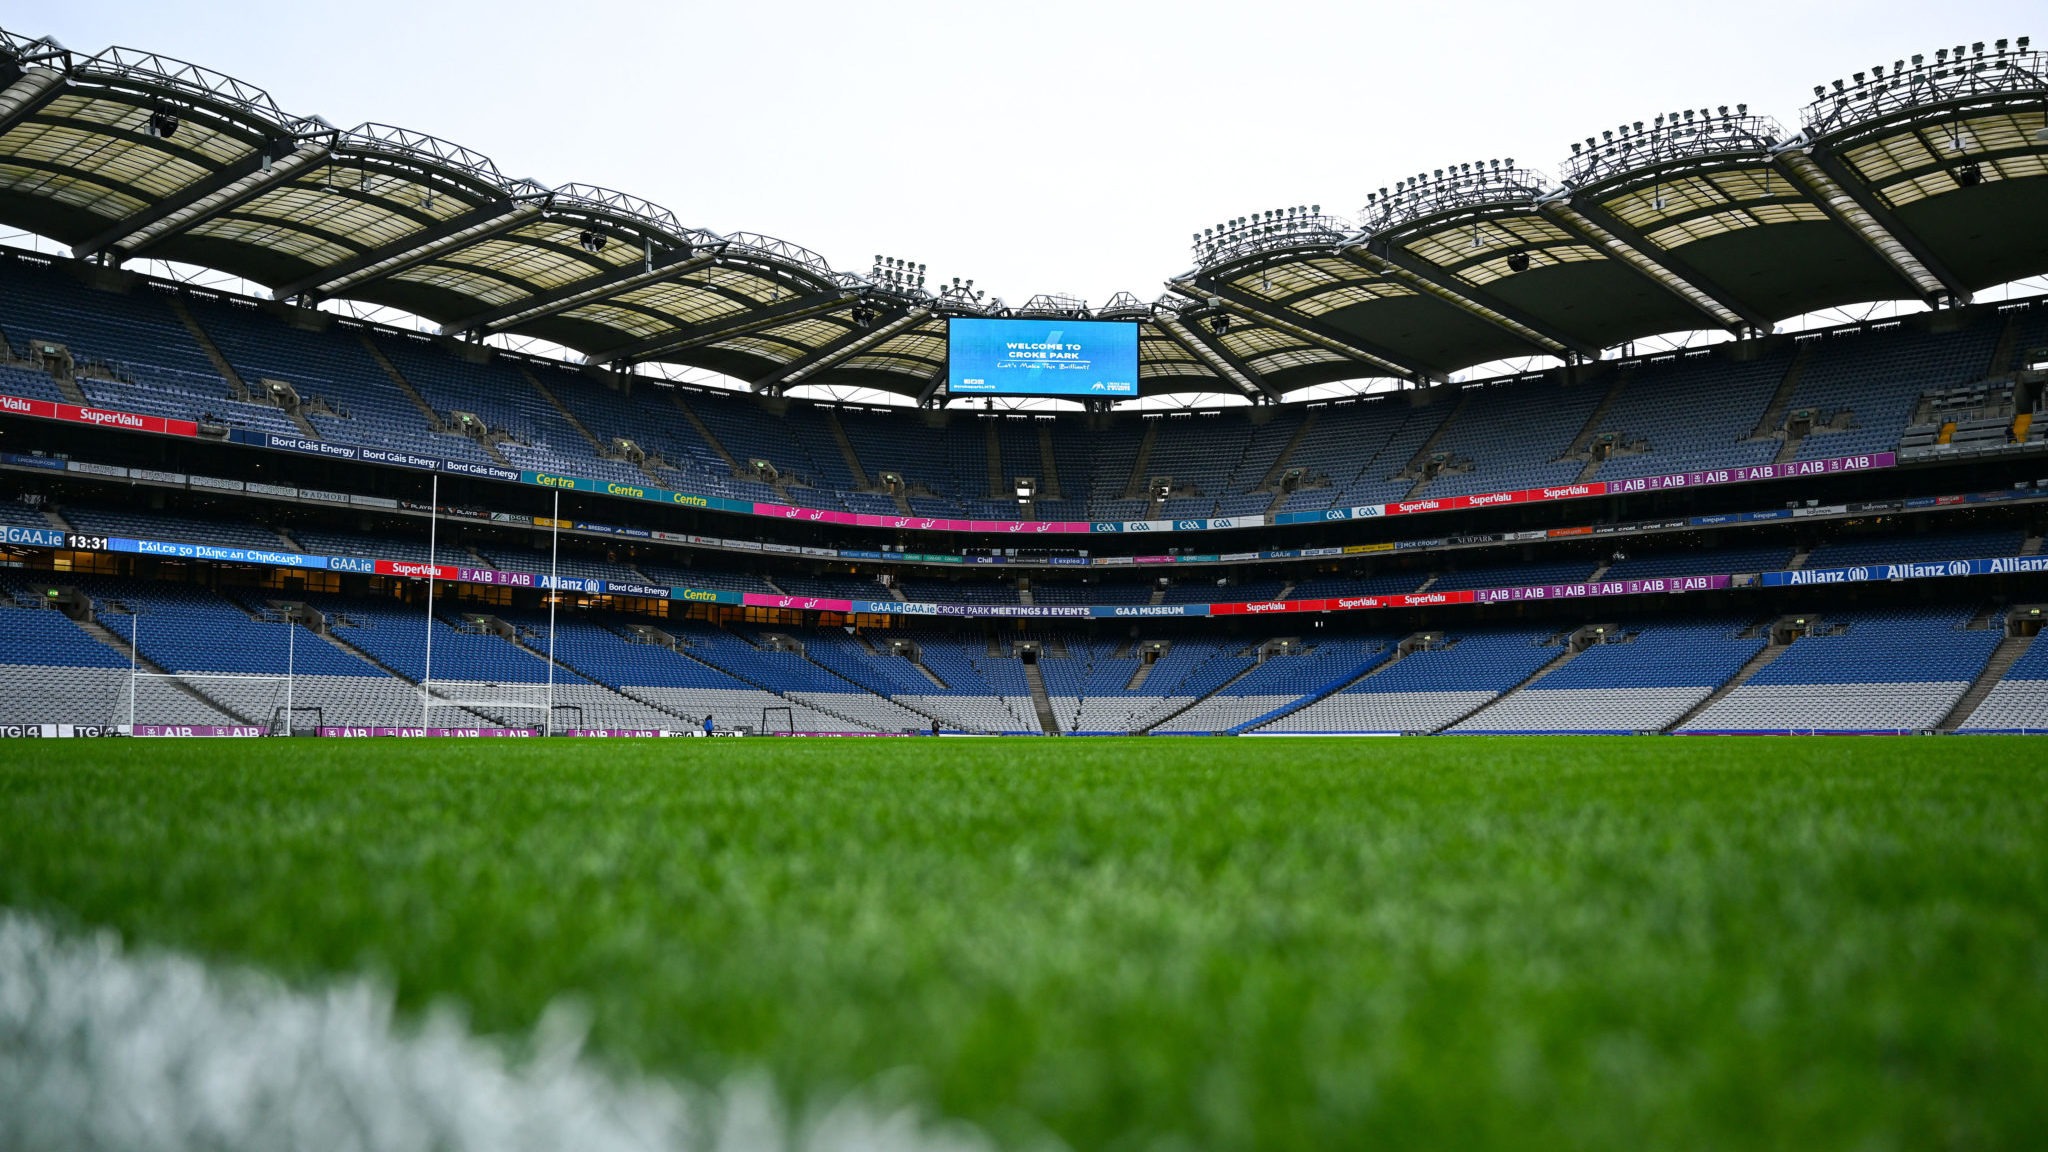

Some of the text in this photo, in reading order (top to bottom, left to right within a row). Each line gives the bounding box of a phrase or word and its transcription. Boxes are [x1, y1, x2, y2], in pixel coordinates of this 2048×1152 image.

[1006, 342, 1081, 351] WELCOME TO
[1008, 351, 1079, 360] CROKE PARK
[1043, 362, 1056, 370] This
[80, 408, 143, 427] SuperValu
[271, 436, 356, 458] Bord Gáis Energy
[363, 449, 386, 460] Bord
[387, 452, 407, 464] Gáis
[1799, 461, 1825, 475] AIB
[1843, 456, 1870, 470] AIB
[447, 461, 519, 480] Bord Gáis Energy
[1750, 466, 1774, 479] AIB
[536, 473, 576, 489] Centra
[1662, 475, 1685, 487] AIB
[1705, 471, 1729, 483] AIB
[607, 483, 644, 498] Centra
[1624, 479, 1646, 491] AIB
[311, 491, 348, 503] ADMORE
[1543, 484, 1589, 499] SuperValu
[673, 493, 707, 507] Centra
[1469, 493, 1512, 506] SuperValu
[1358, 506, 1378, 517] GAA
[1399, 500, 1439, 513] SuperValu
[786, 507, 800, 518] eir
[810, 509, 824, 520] eir
[1326, 509, 1345, 520] GAA
[1753, 511, 1778, 519] Kingspan
[587, 523, 612, 532] BREEDON
[895, 517, 910, 528] eir
[921, 518, 936, 529] eir
[1009, 521, 1025, 532] eir
[1036, 521, 1052, 532] eir
[1096, 523, 1117, 532] GAA
[1130, 522, 1150, 531] GAA
[1179, 520, 1200, 530] GAA
[1213, 518, 1232, 528] GAA
[9, 528, 62, 546] GAA.ie
[626, 529, 649, 537] BREEDON
[69, 535, 108, 550] 13:31
[1457, 535, 1493, 544] NEWPARK
[179, 546, 193, 557] go
[230, 551, 244, 559] an
[330, 557, 372, 572] GAA.ie
[977, 556, 993, 564] Chill
[1989, 557, 2048, 573] Allianz
[472, 570, 493, 582] AIB
[1887, 563, 1945, 579] Allianz
[510, 574, 530, 585] AIB
[540, 575, 583, 590] Allianz
[1684, 578, 1707, 588] AIB
[1790, 570, 1845, 585] Allianz
[609, 583, 669, 597] Bord Gáis Energy
[1565, 585, 1586, 596] AIB
[1601, 583, 1623, 593] AIB
[1642, 580, 1664, 591] AIB
[684, 589, 717, 601] Centra
[1489, 589, 1509, 600] AIB
[1524, 588, 1545, 598] AIB
[779, 596, 794, 608] eir
[804, 597, 818, 609] eir
[1338, 597, 1377, 608] SuperValu
[1404, 594, 1445, 606] SuperValu
[870, 602, 902, 613] GAA.ie
[904, 603, 935, 614] GAA.ie
[936, 605, 1090, 615] CROKE PARK MEETINGS & EVENTS
[1115, 606, 1184, 615] GAA MUSEUM
[1246, 602, 1285, 613] SuperValu
[164, 727, 193, 737] AIB
[232, 727, 260, 737] AIB
[343, 728, 368, 737] AIB
